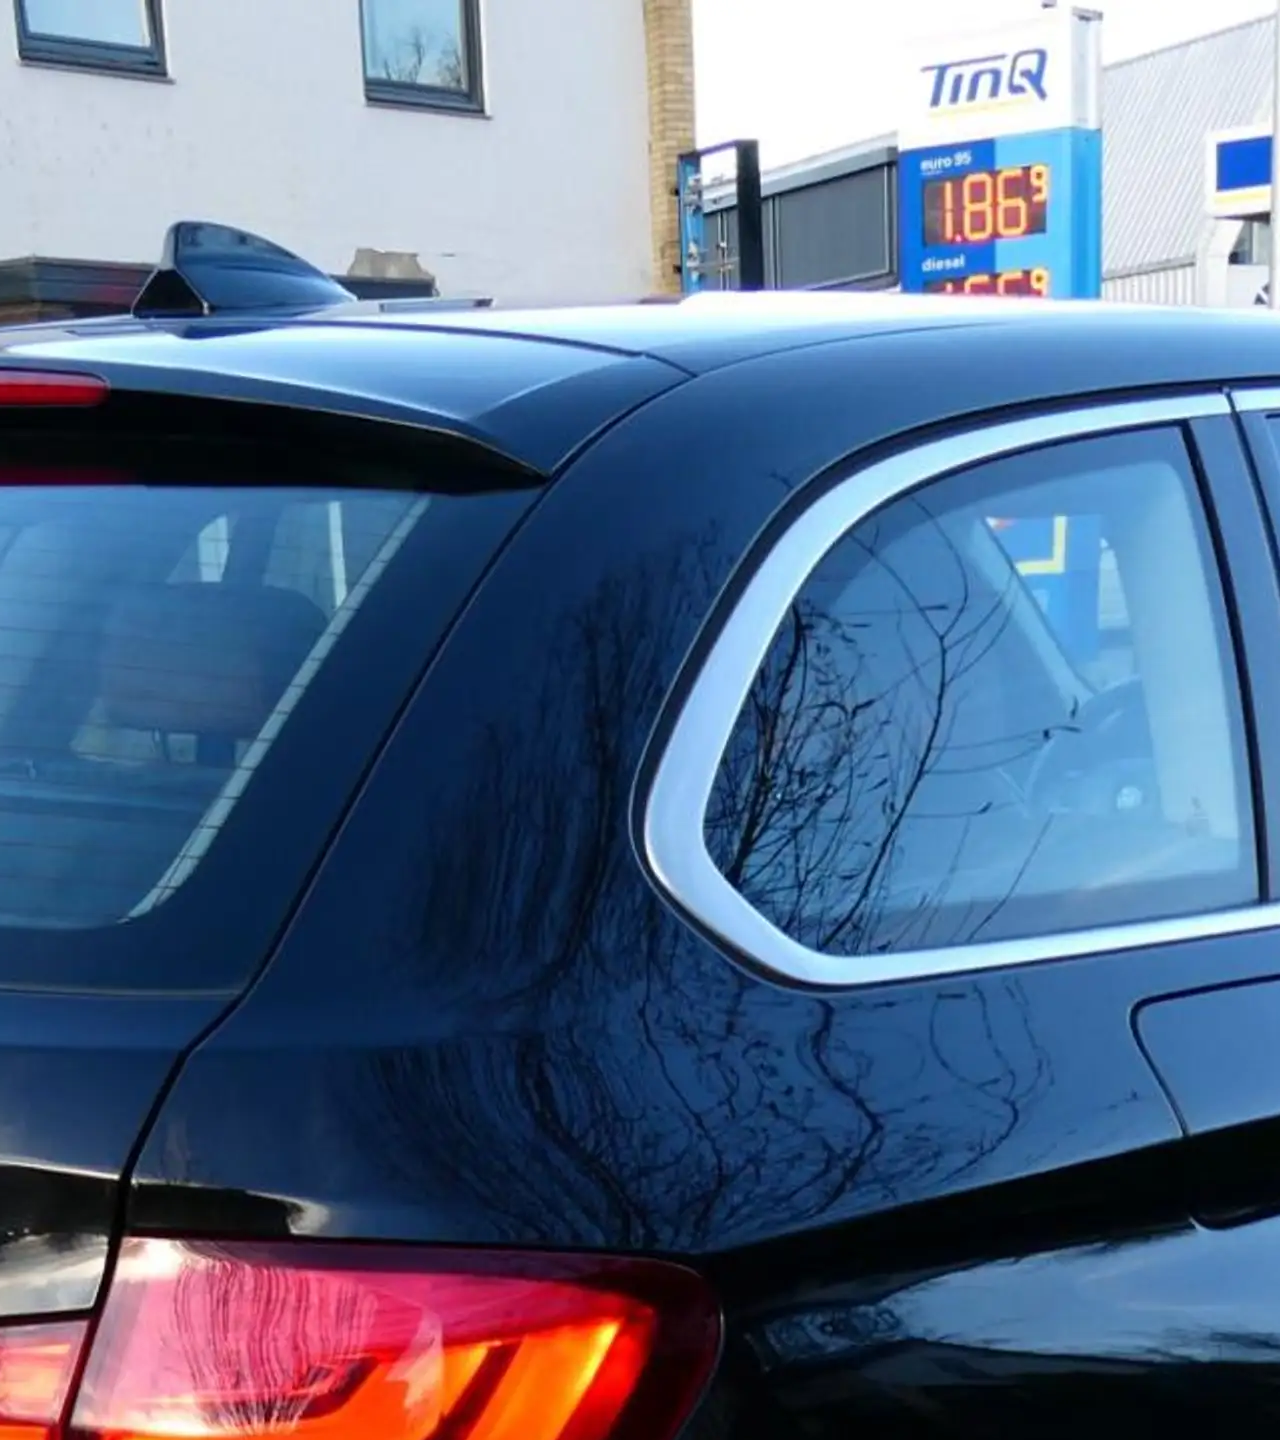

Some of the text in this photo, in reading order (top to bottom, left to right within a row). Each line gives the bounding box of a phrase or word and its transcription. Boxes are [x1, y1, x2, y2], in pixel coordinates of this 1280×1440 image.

[920, 49, 1048, 108] TinQ
[921, 156, 952, 171] euro
[922, 254, 966, 273] diesel
